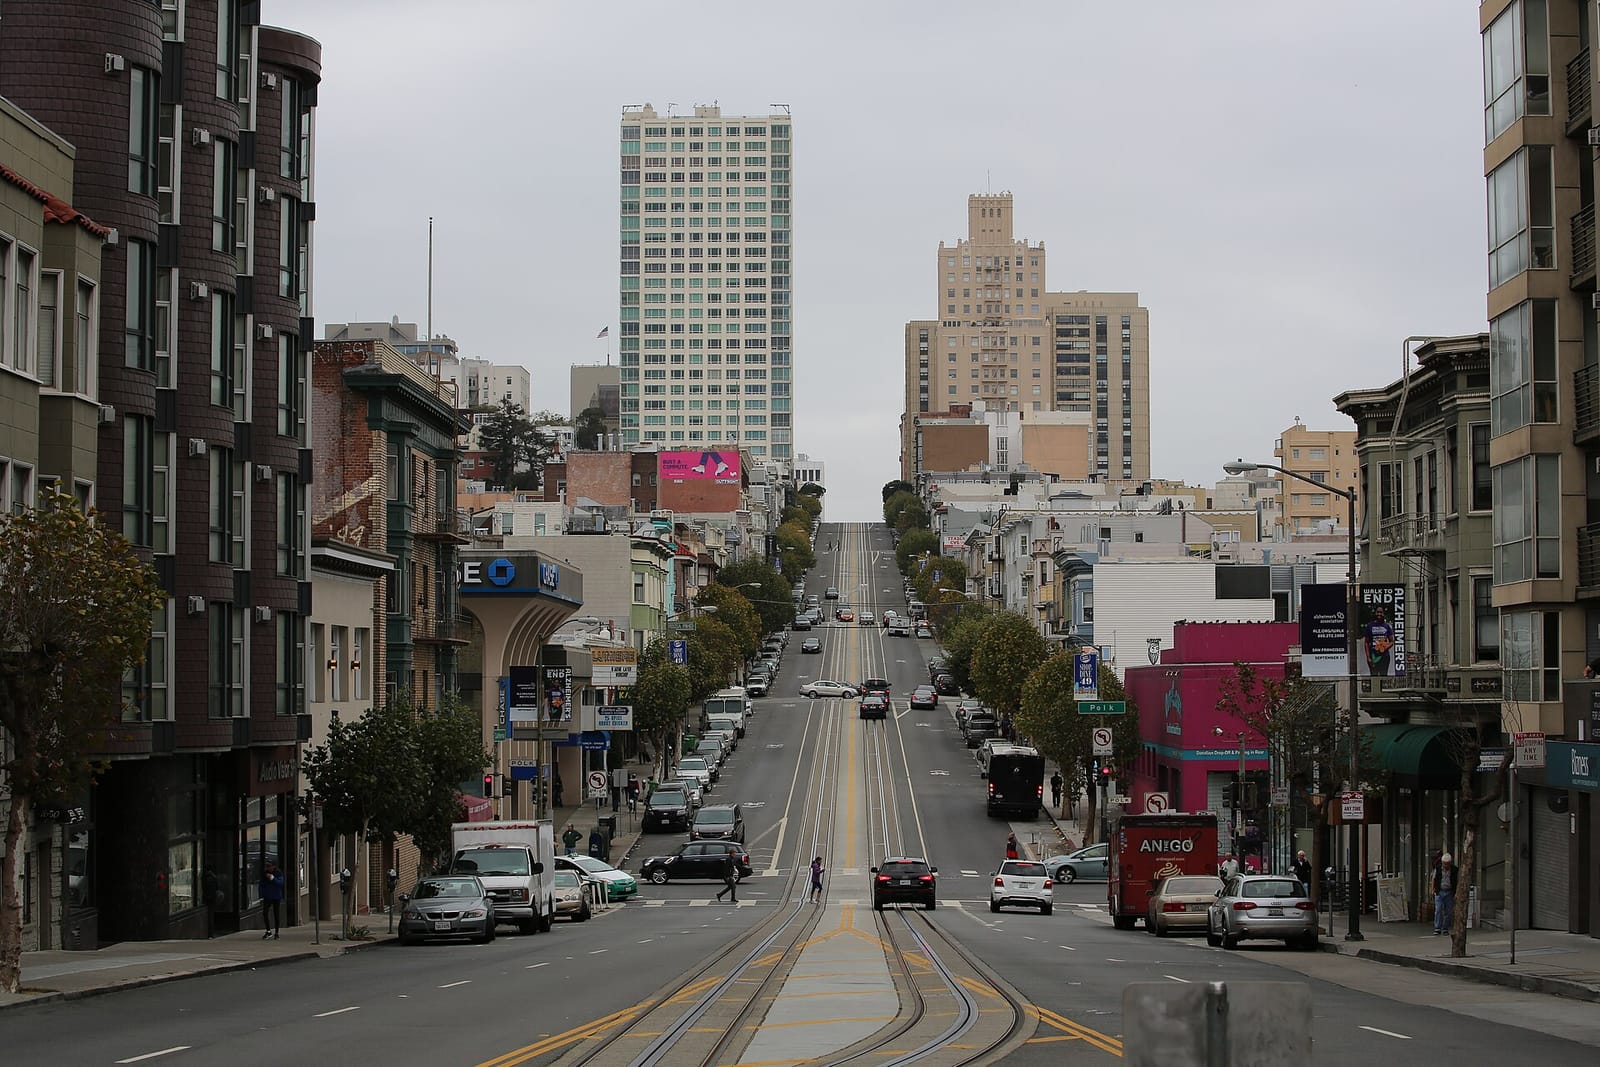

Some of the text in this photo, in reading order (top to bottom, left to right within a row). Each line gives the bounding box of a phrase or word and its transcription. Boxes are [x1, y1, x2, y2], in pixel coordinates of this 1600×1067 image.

[1363, 594, 1393, 604] END
[1394, 587, 1405, 671] ALZHEIMER'S
[1080, 677, 1092, 686] 49
[1140, 839, 1163, 852] AN
[1170, 839, 1194, 853] GO
